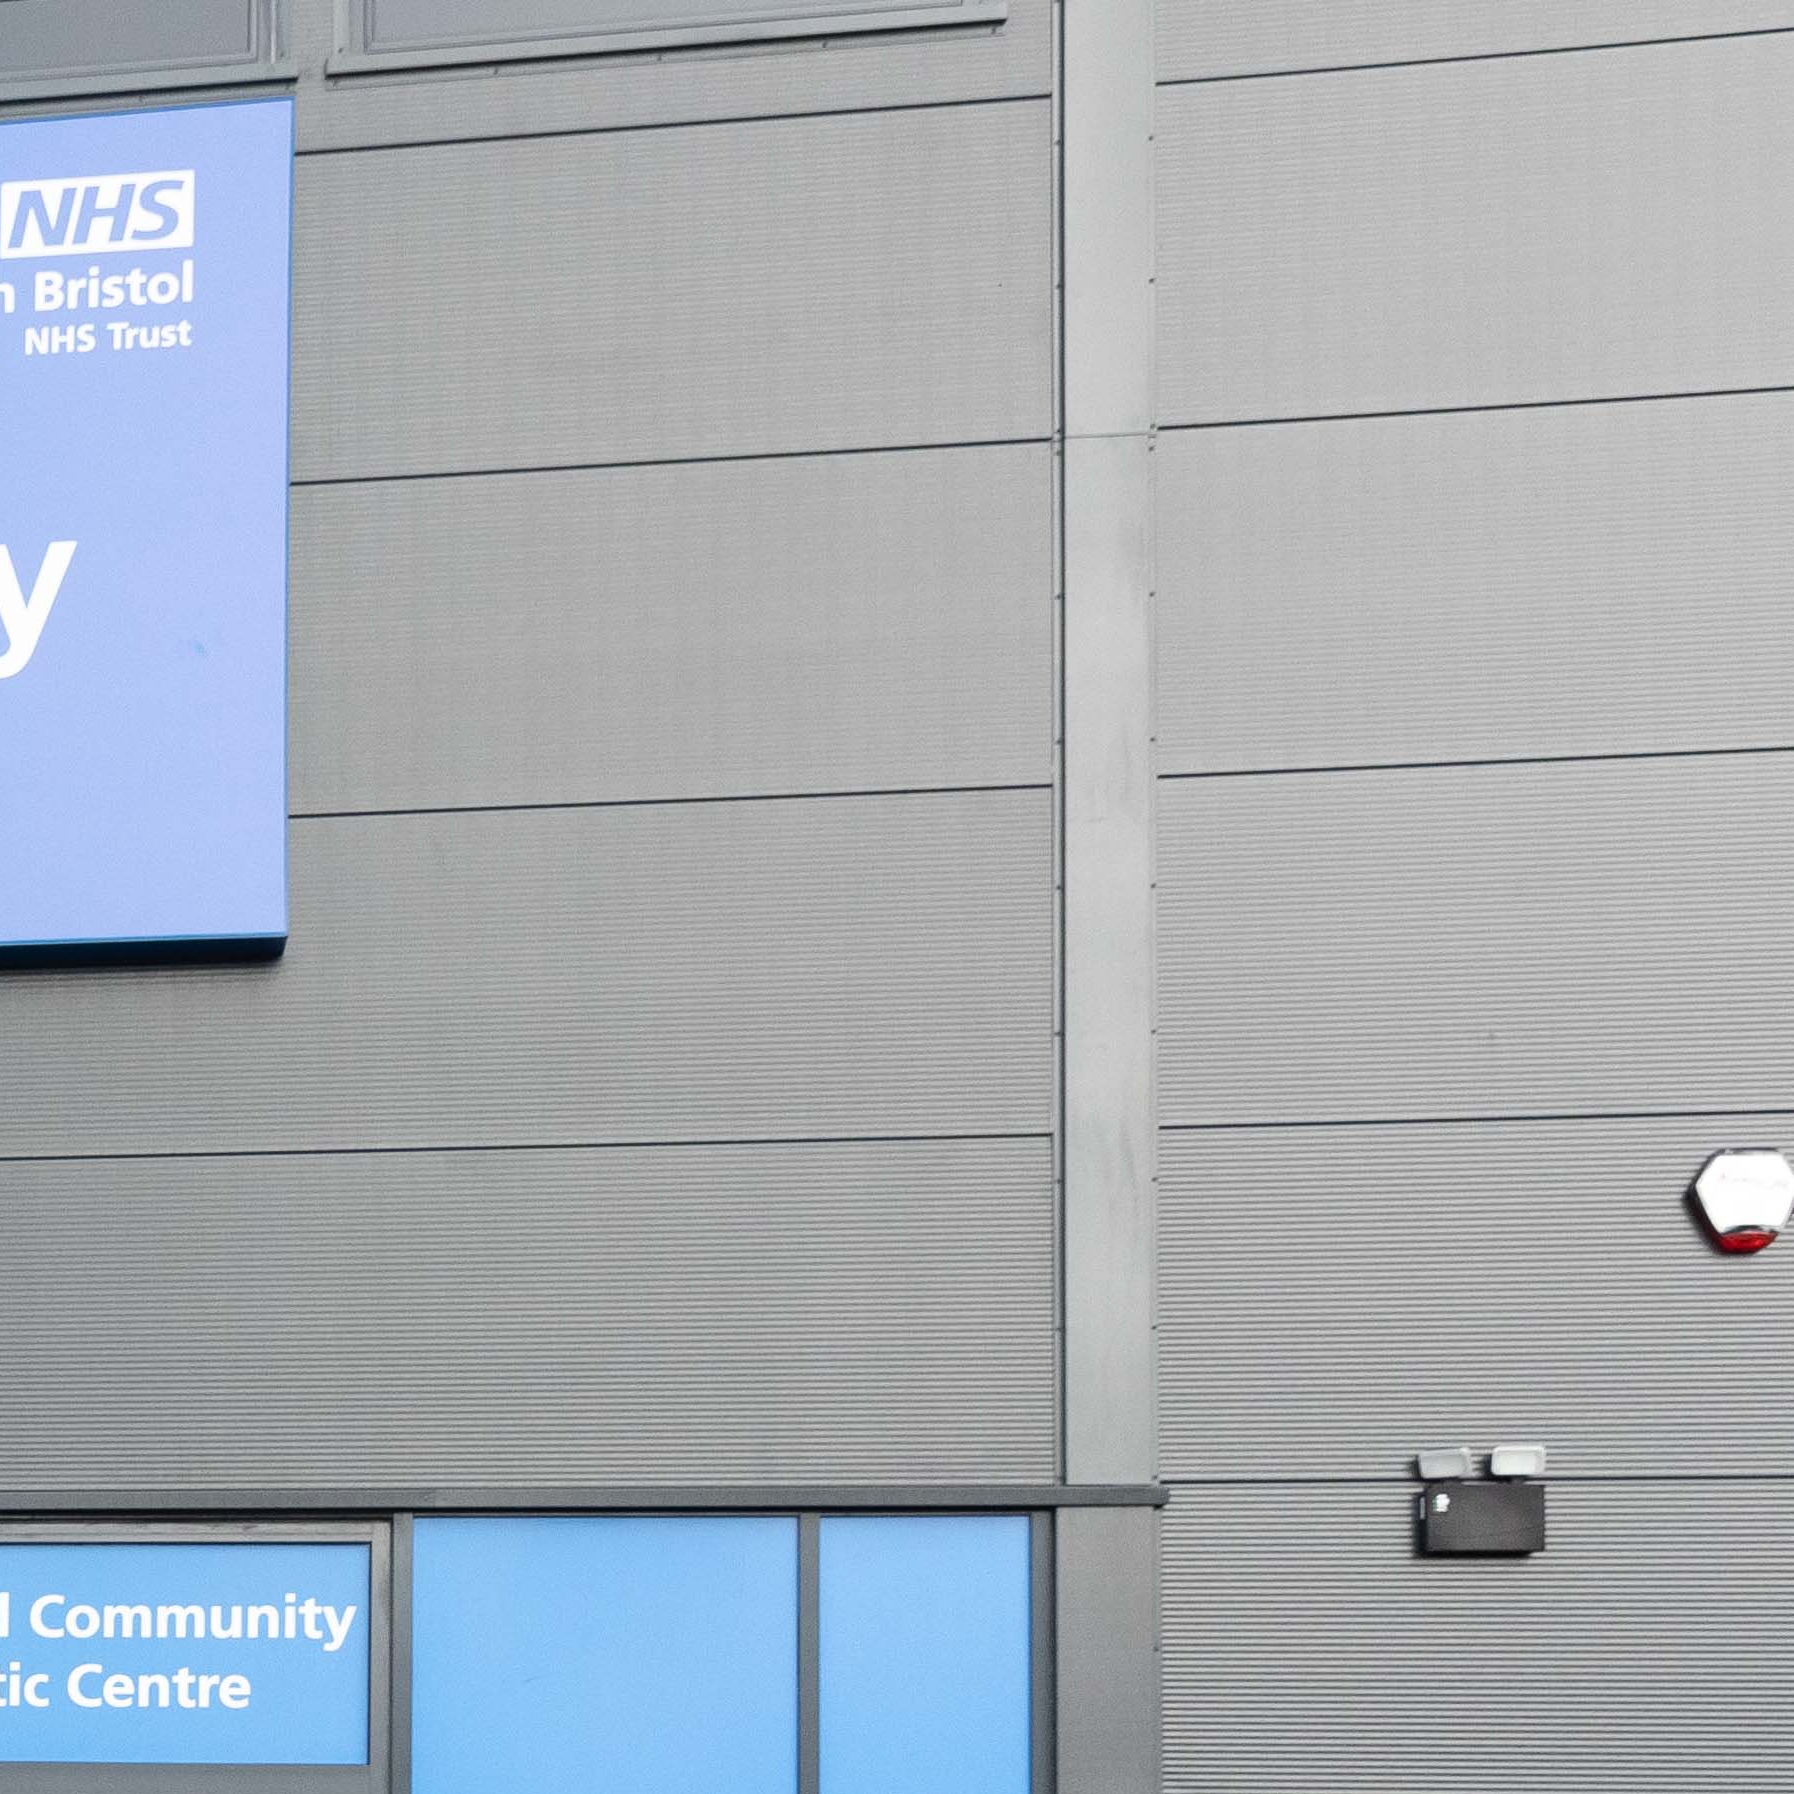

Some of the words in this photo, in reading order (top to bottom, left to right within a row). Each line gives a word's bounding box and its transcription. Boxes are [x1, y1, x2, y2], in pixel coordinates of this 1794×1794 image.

[6, 180, 186, 250] NHS
[35, 259, 194, 312] Bristol
[24, 324, 96, 356] NHS
[107, 319, 192, 350] Trust
[29, 1592, 358, 1652] Community
[67, 1663, 252, 1709] Centre
